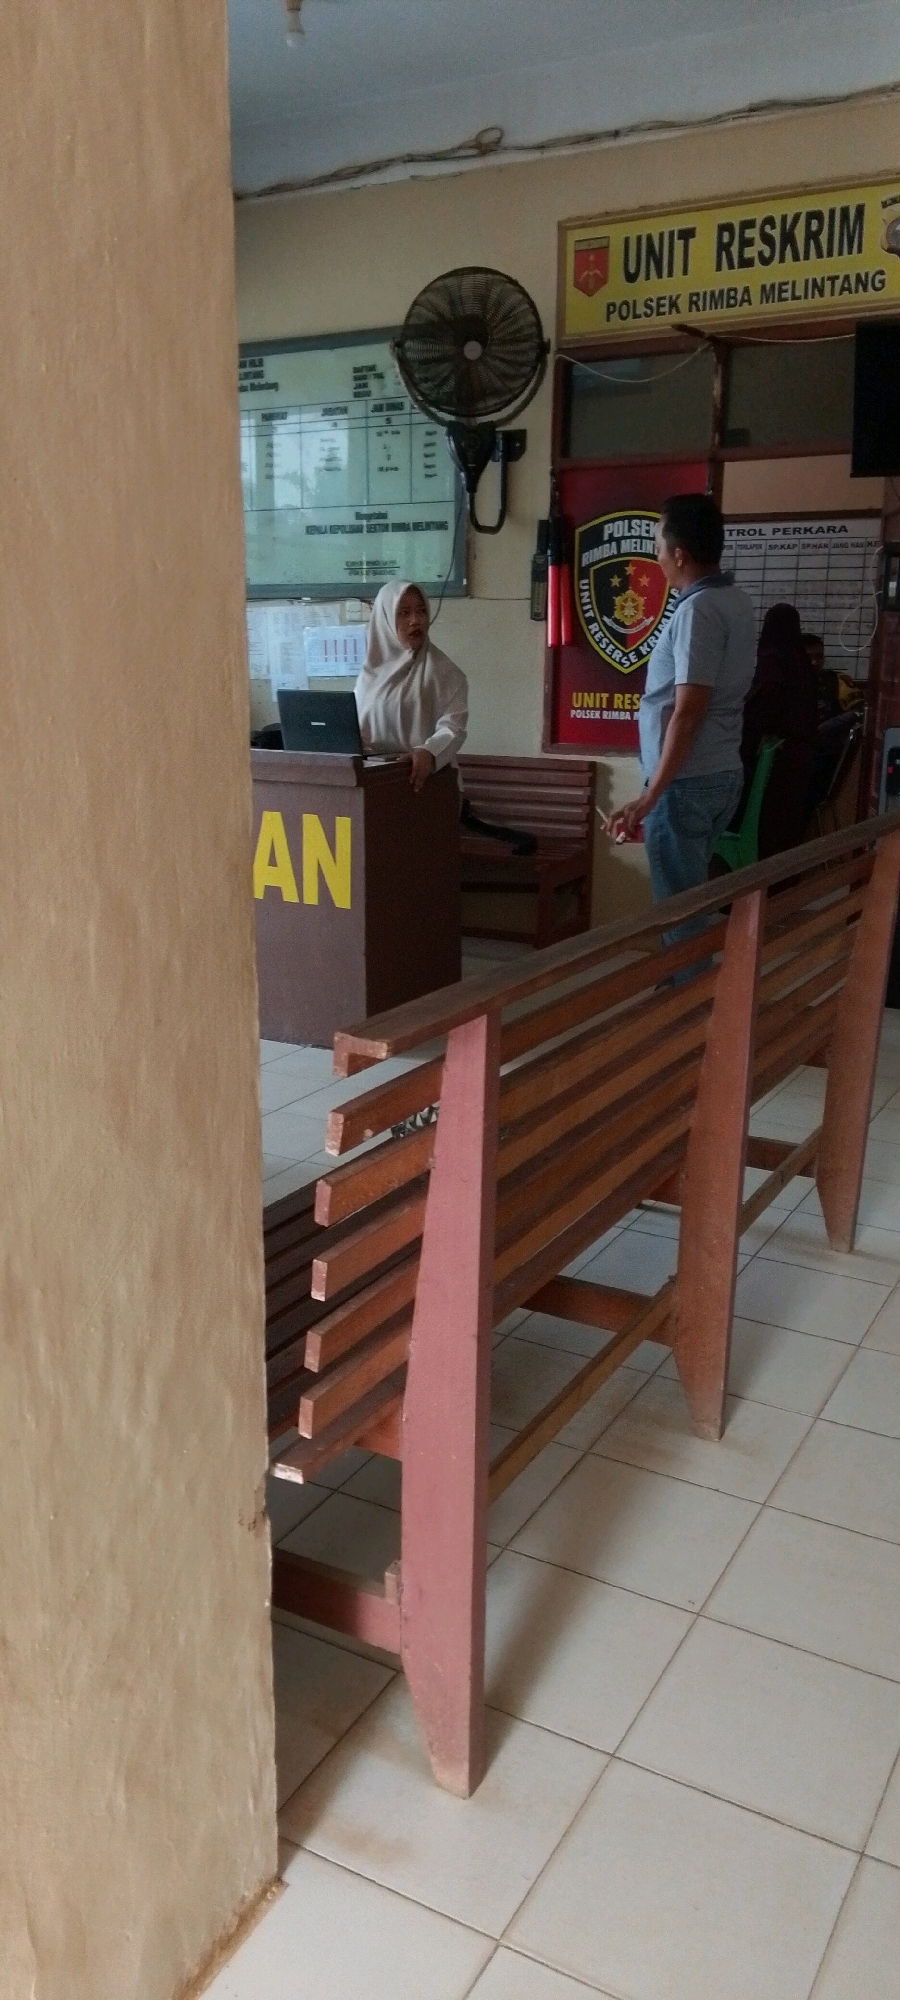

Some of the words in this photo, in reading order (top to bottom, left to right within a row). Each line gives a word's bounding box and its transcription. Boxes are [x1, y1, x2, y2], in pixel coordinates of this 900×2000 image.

[623, 226, 697, 284] UNIT
[715, 203, 866, 272] RESKRIM
[605, 293, 682, 322] POLSEK
[688, 285, 752, 313] RIMBA
[760, 269, 886, 305] MELINTANG
[726, 528, 767, 537] TROL
[772, 525, 849, 536] PERKARA
[581, 541, 618, 567] RIMBA
[579, 579, 595, 619] UNIT
[588, 622, 638, 669] RESERSE
[640, 587, 681, 656] KRIMINA
[570, 710, 600, 719] POLSEK
[602, 710, 631, 720] RIMBA
[572, 692, 610, 708] UNIT
[613, 693, 641, 709] RES
[253, 810, 351, 910] AN
